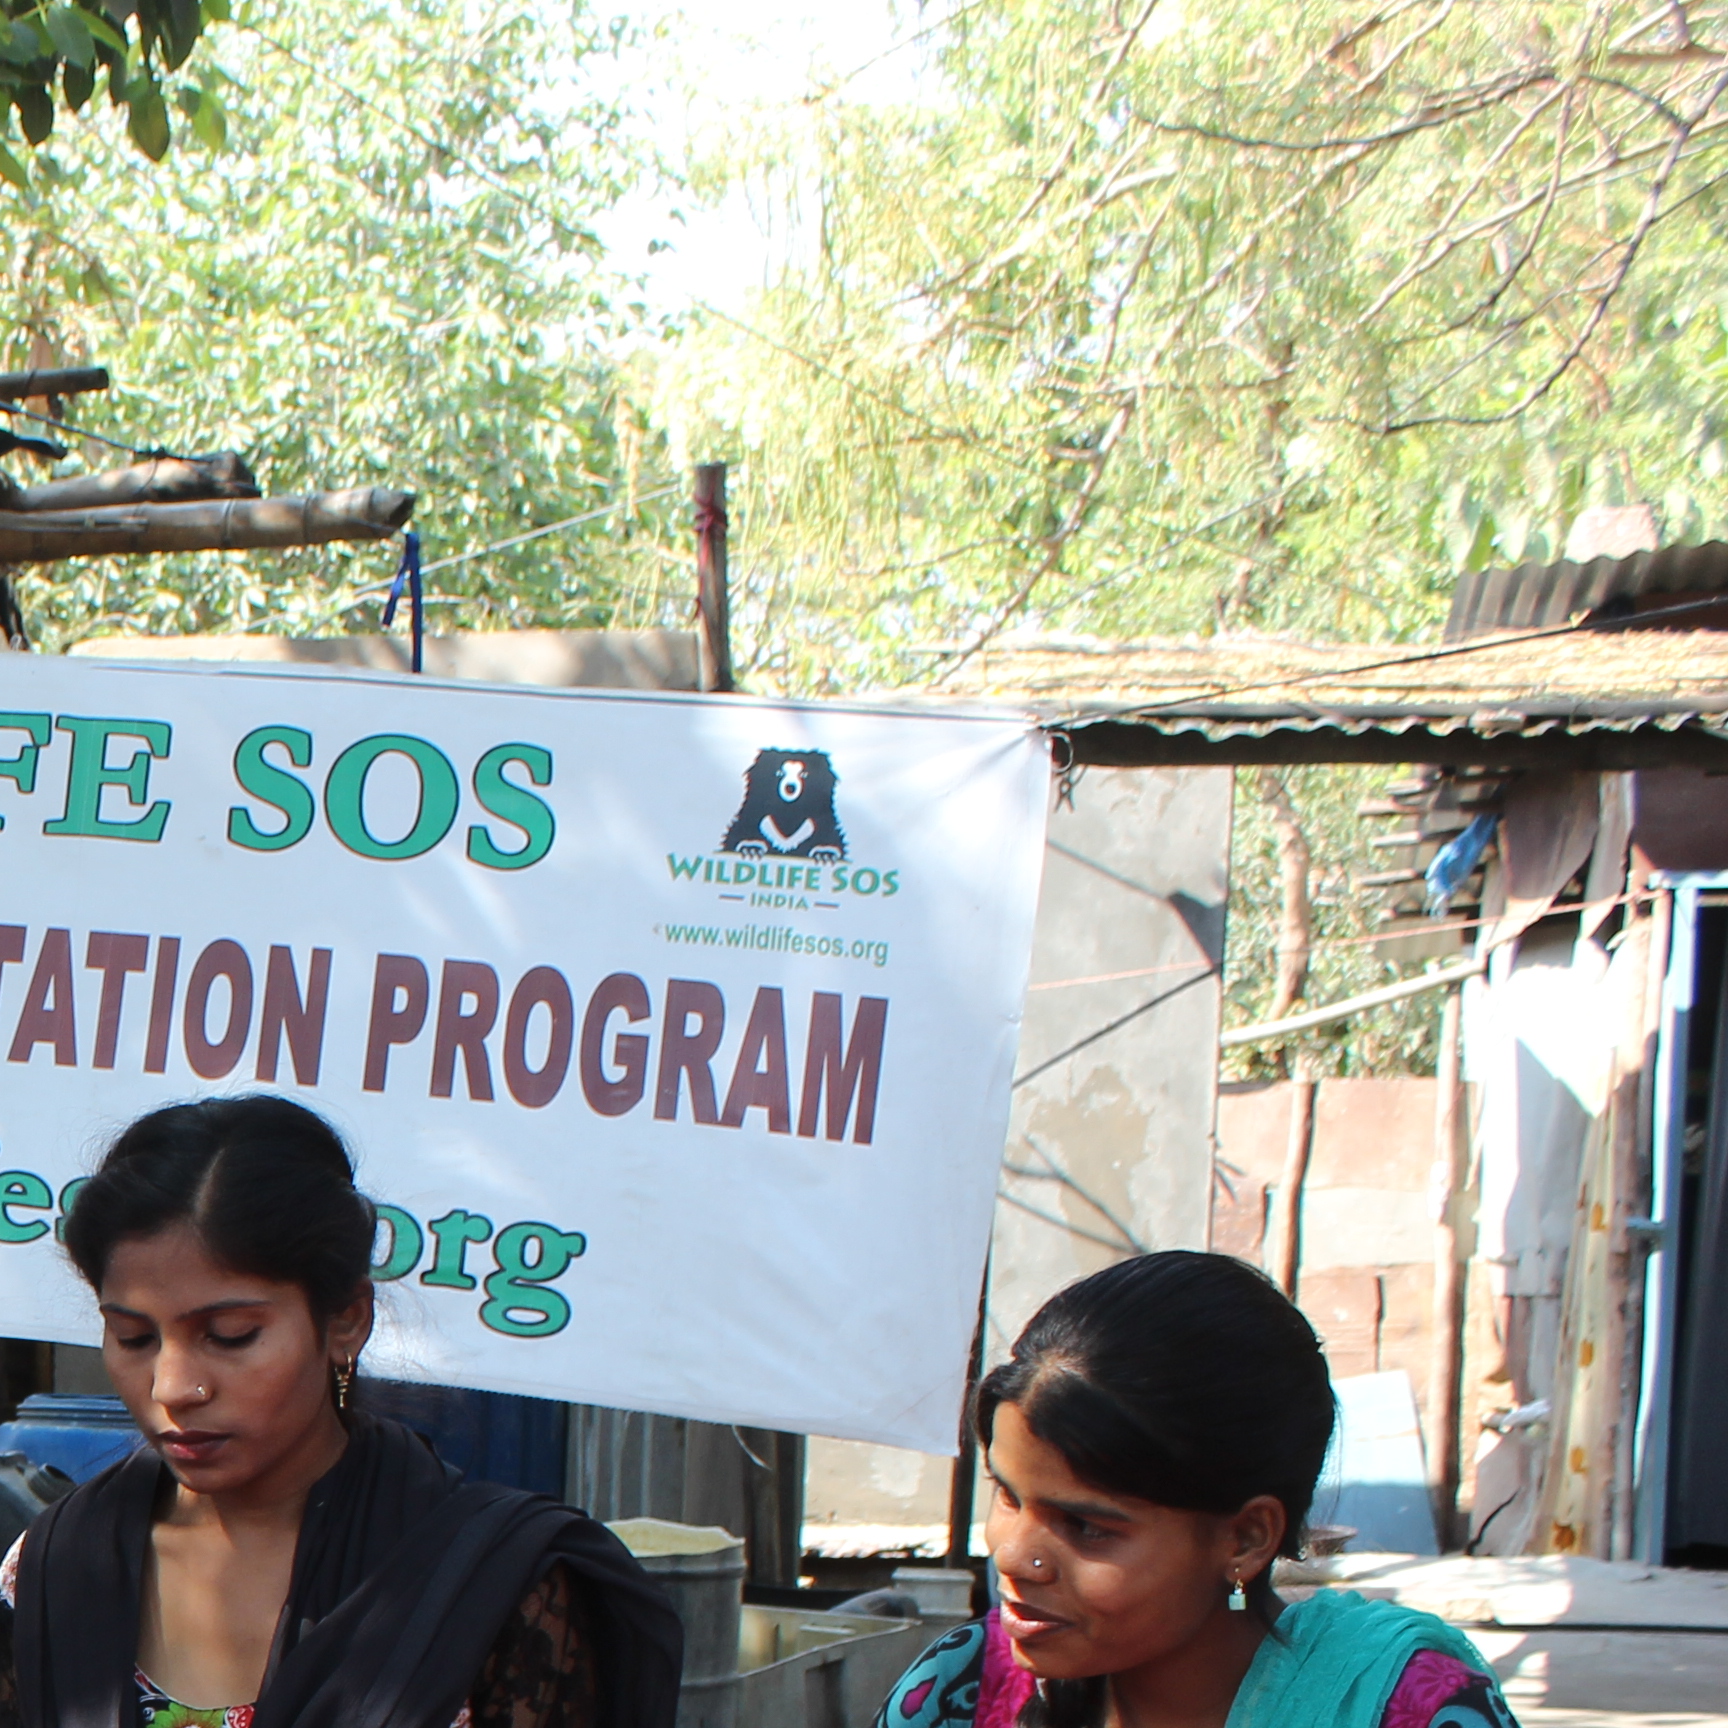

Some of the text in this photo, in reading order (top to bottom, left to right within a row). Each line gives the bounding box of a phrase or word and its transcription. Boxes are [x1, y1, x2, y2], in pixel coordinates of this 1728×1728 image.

[228, 724, 554, 869] SOS
[665, 852, 901, 897] WILDLIFE SOS
[749, 891, 810, 911] INDIA
[664, 922, 890, 967] www.wildlifesos.org
[363, 955, 888, 1144] PROGRAM
